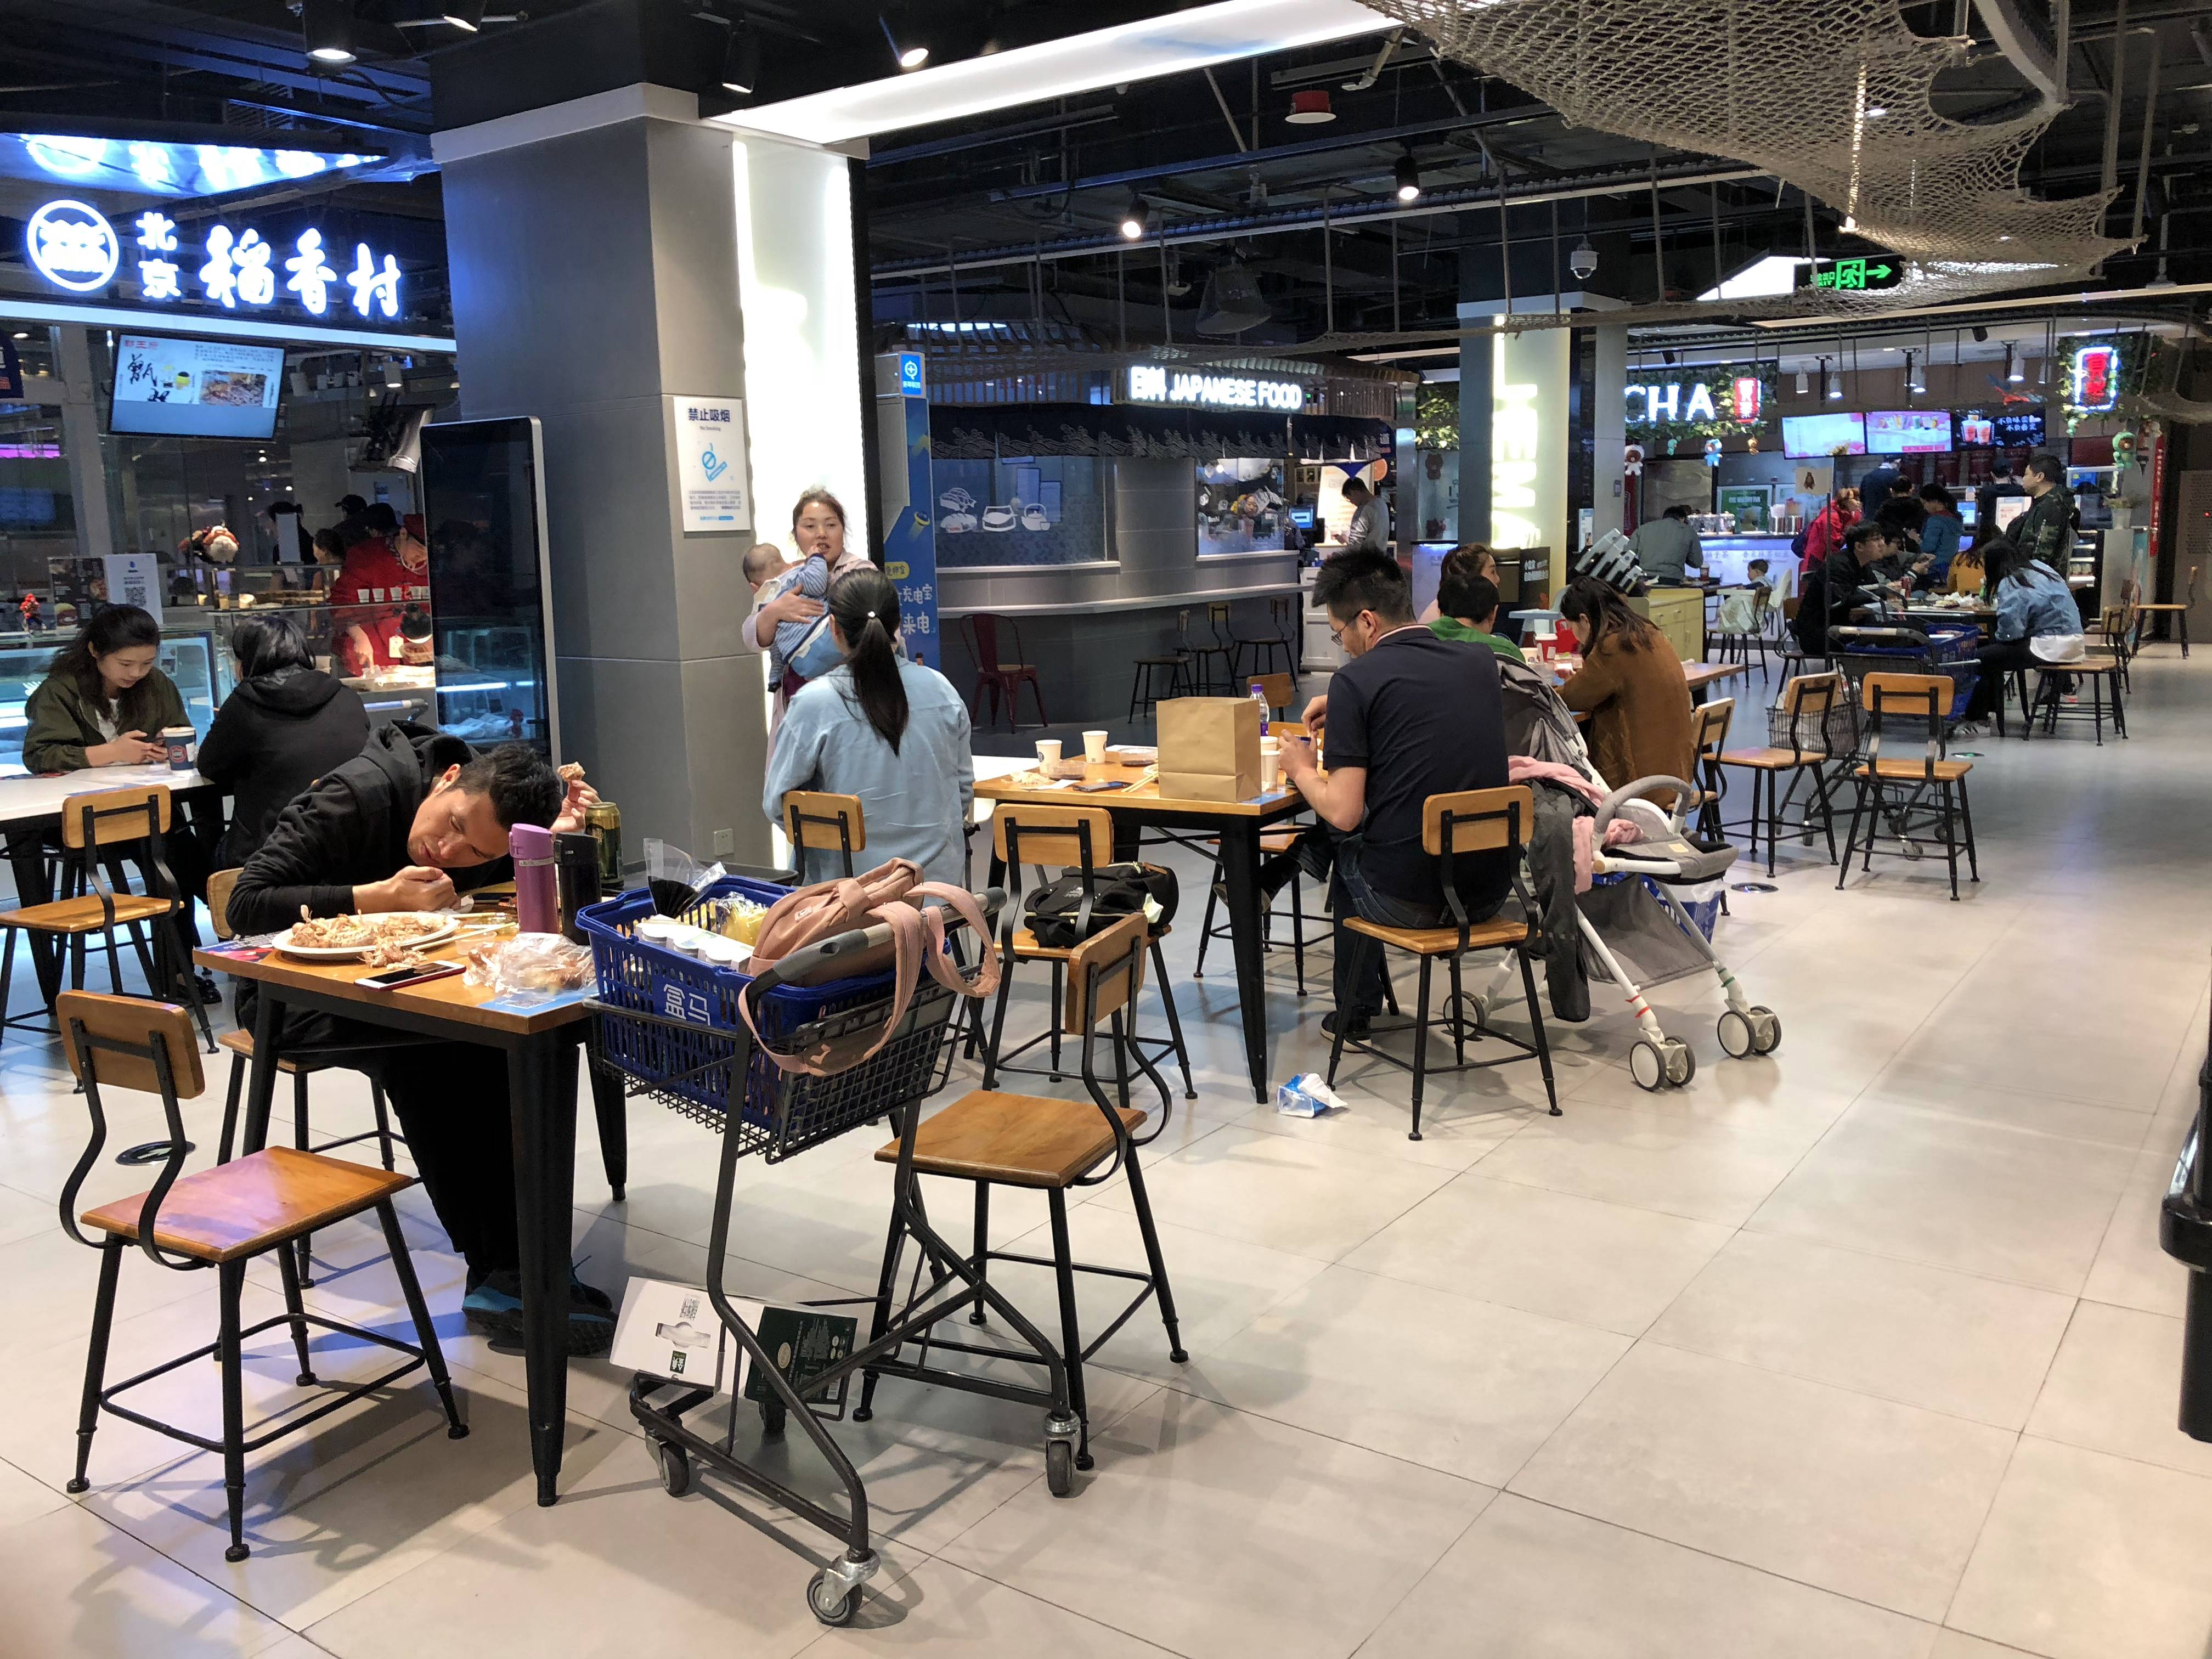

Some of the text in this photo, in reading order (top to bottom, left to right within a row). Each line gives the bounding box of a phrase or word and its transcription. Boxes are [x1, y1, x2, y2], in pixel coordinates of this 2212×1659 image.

[136, 212, 402, 317] 北京 稻香村
[1170, 374, 1256, 406] JAPANESE
[1258, 381, 1302, 409] FOOD
[1624, 383, 1717, 422] CHA
[688, 407, 730, 422] 禁止吸烟
[663, 984, 710, 1026] 盒马
